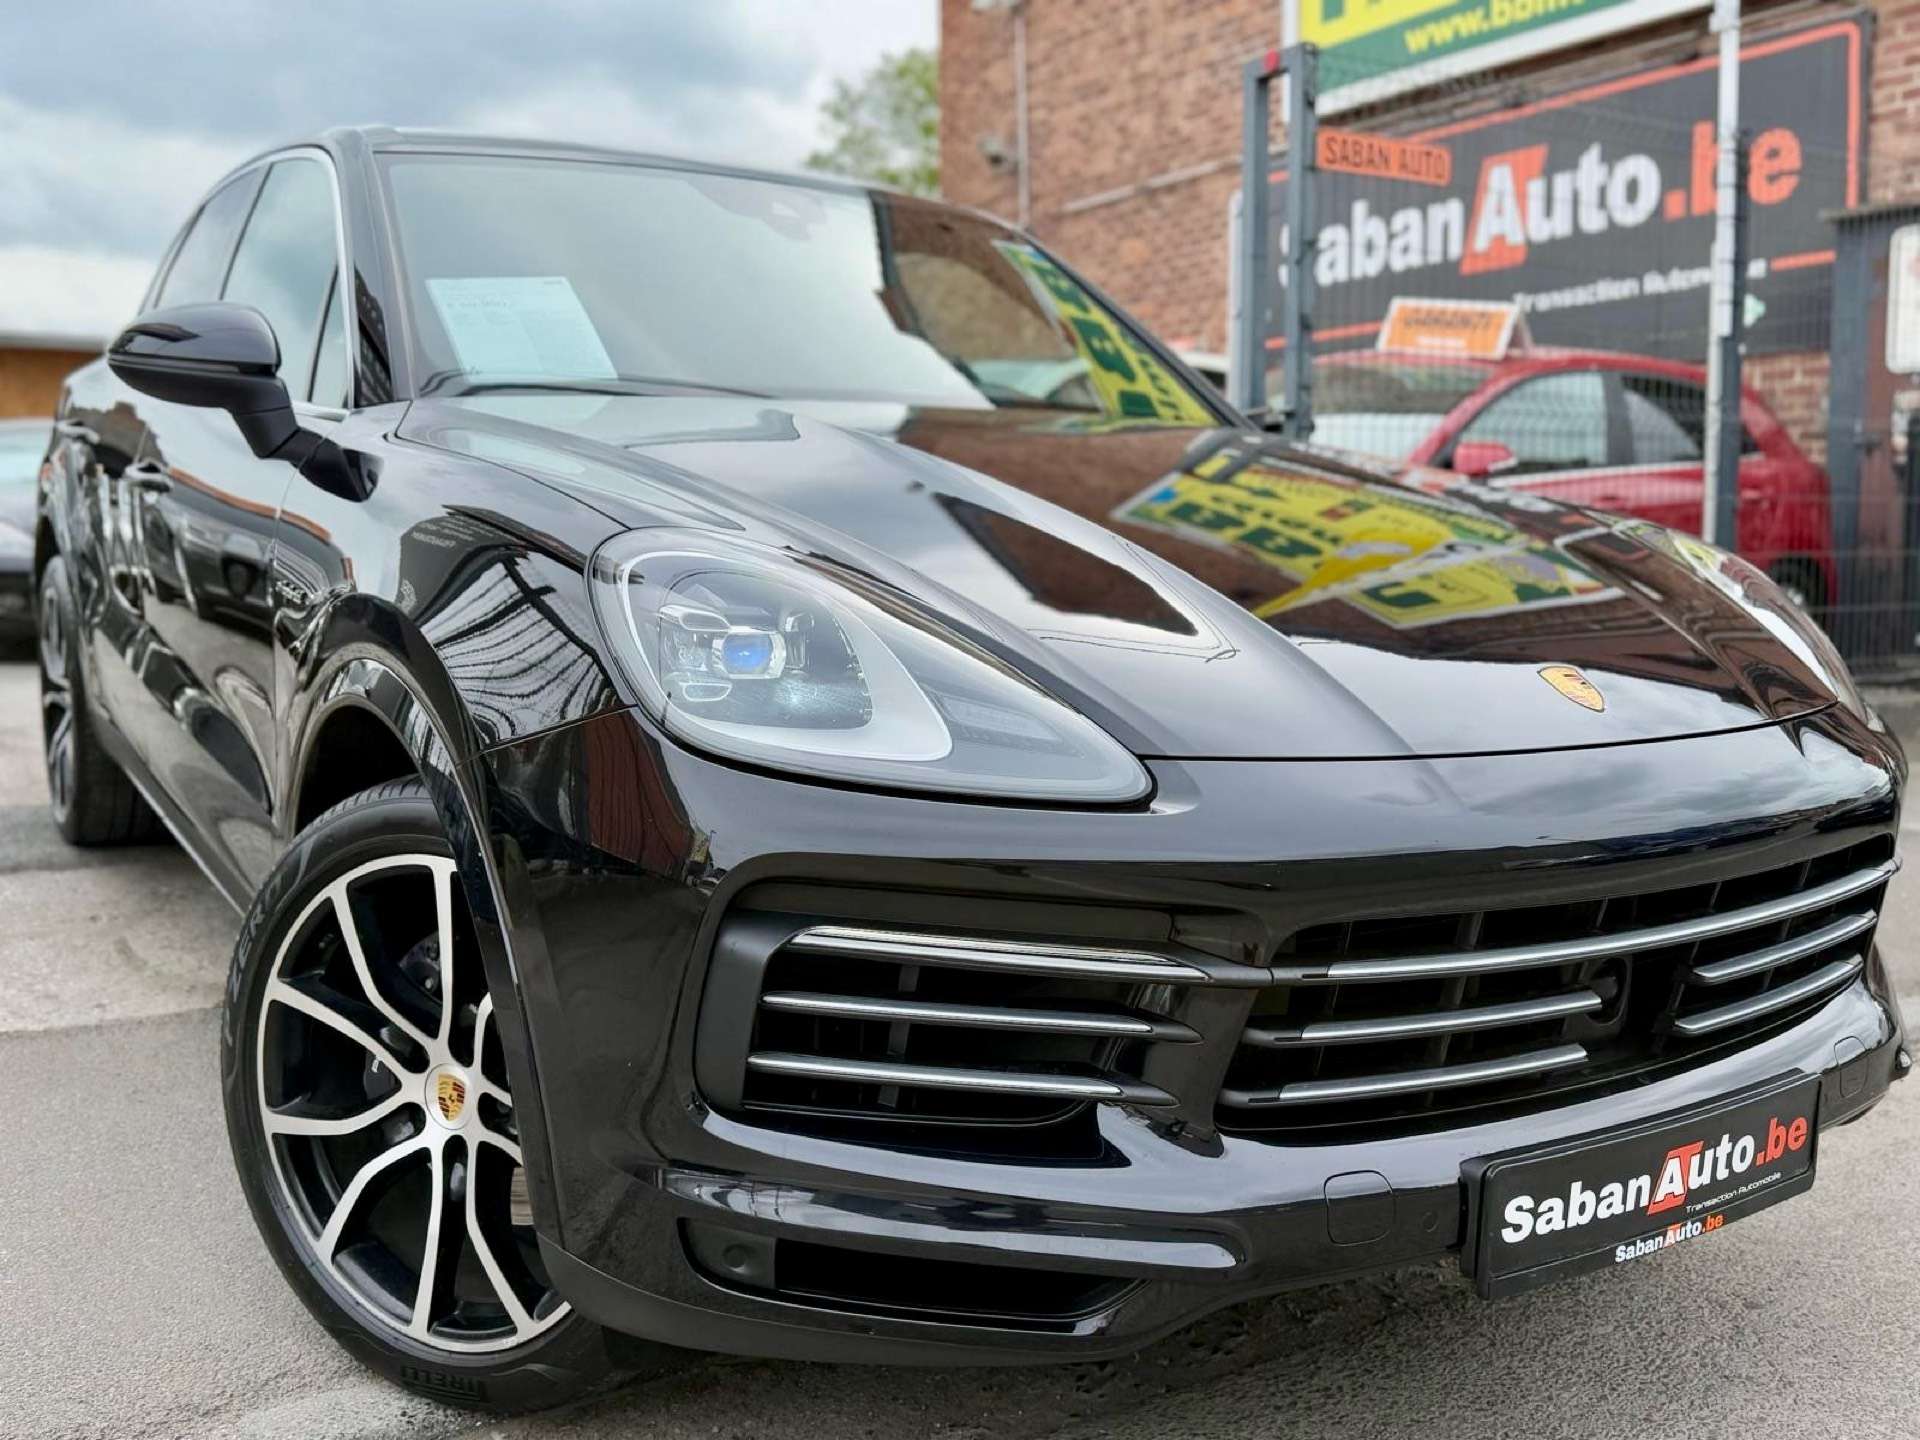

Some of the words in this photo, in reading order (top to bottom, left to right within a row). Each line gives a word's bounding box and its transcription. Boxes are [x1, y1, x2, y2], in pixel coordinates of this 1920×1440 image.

[1324, 135, 1392, 171] SABAN
[1399, 147, 1447, 180] AUTO
[1500, 1115, 1809, 1243] SabanAuto.be
[1685, 1189, 1738, 1214] Transaction
[1738, 1171, 1782, 1195] Automobile
[1614, 1213, 1724, 1262] SabanAuto.be
